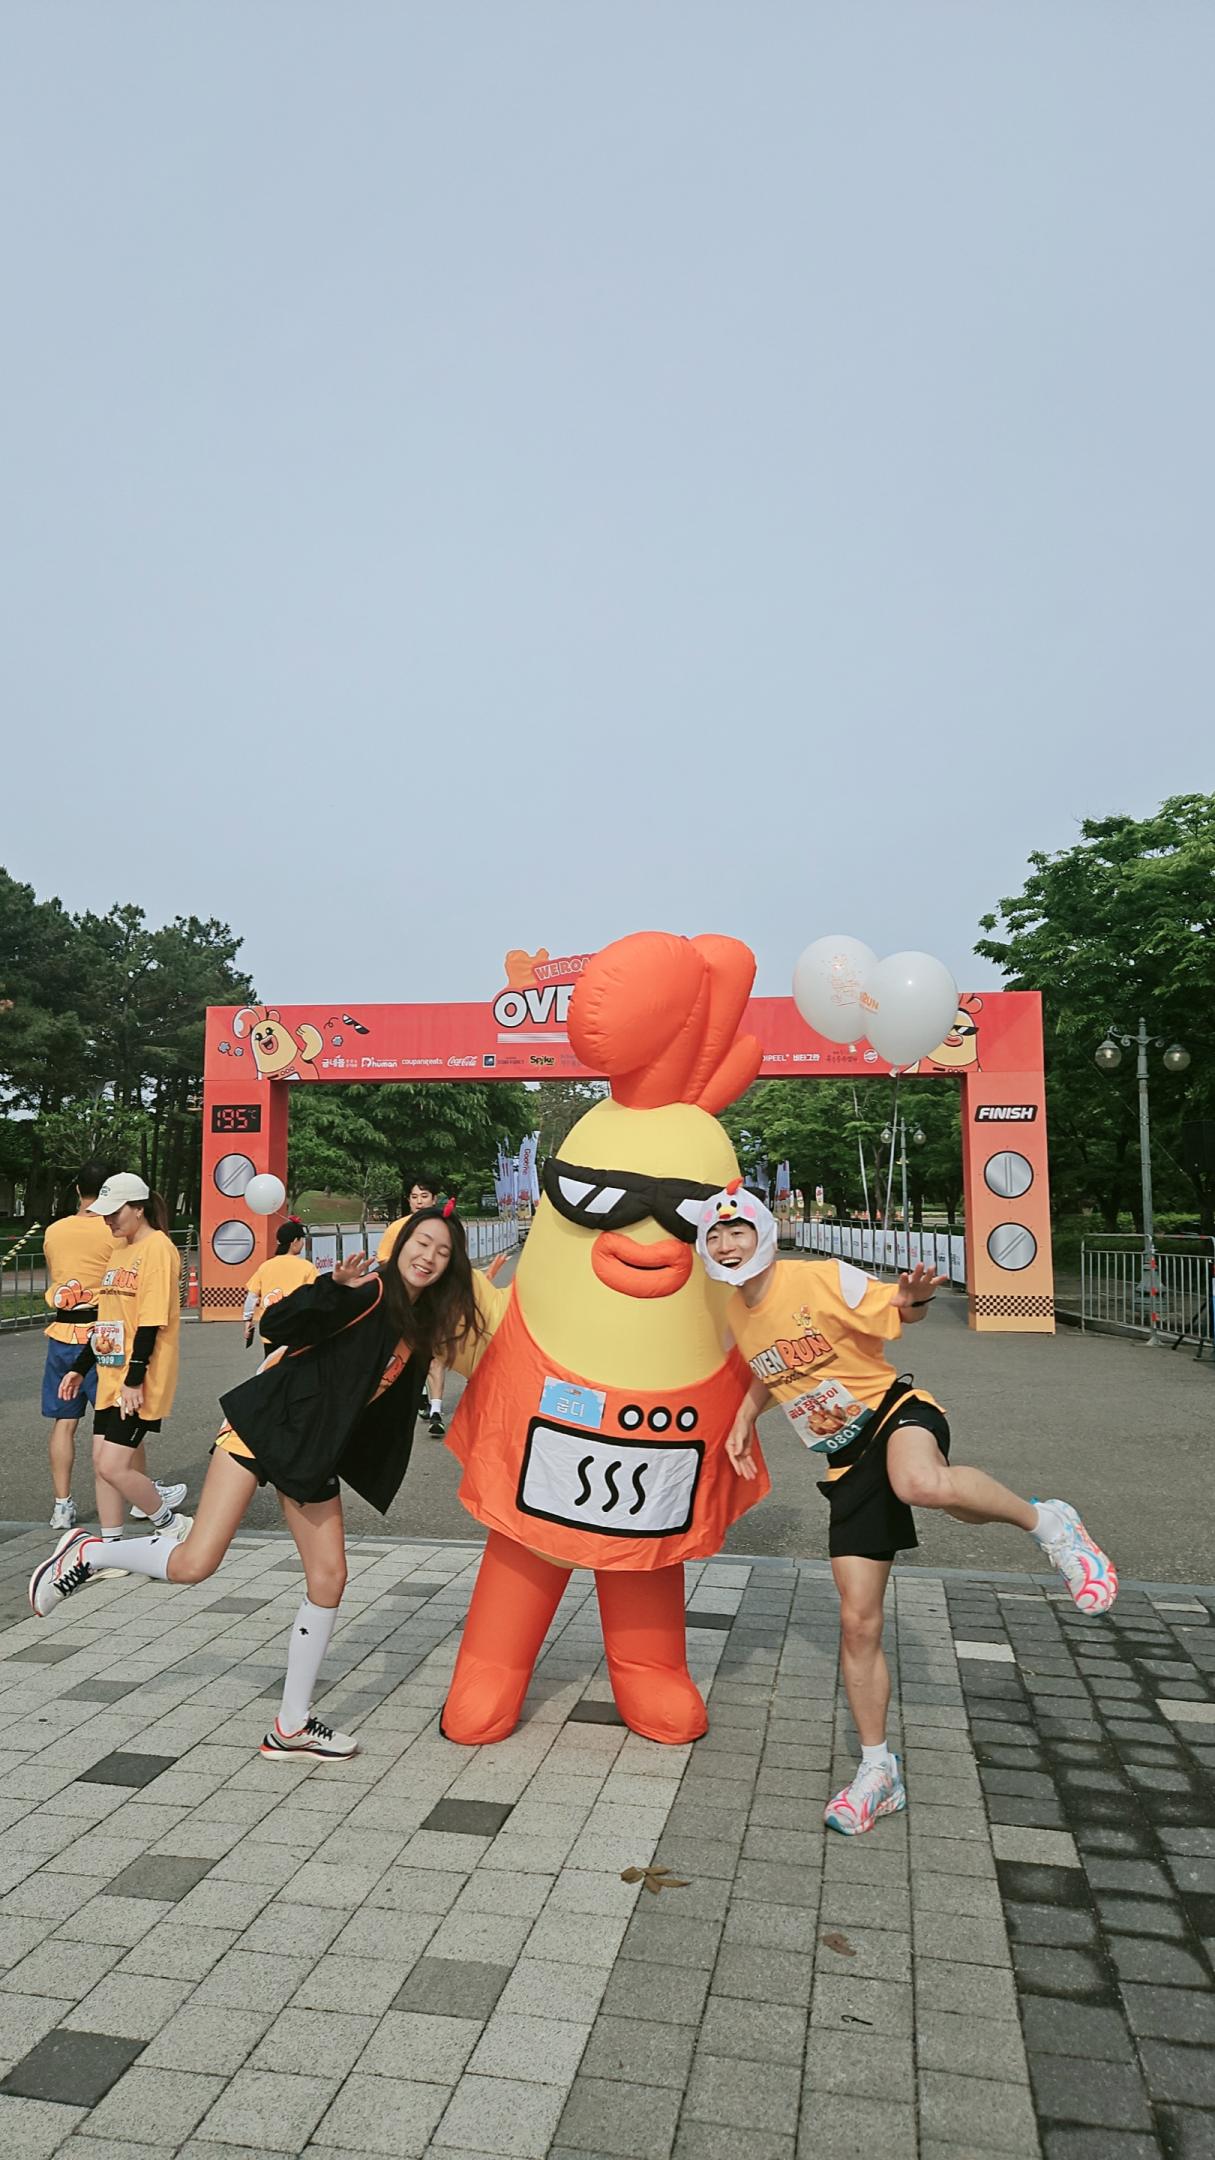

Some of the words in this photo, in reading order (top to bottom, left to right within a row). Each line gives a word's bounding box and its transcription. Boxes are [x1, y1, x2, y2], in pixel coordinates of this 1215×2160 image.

[529, 1055, 555, 1066] Spike
[978, 1107, 1034, 1120] FINISH
[775, 1333, 833, 1370] RUN
